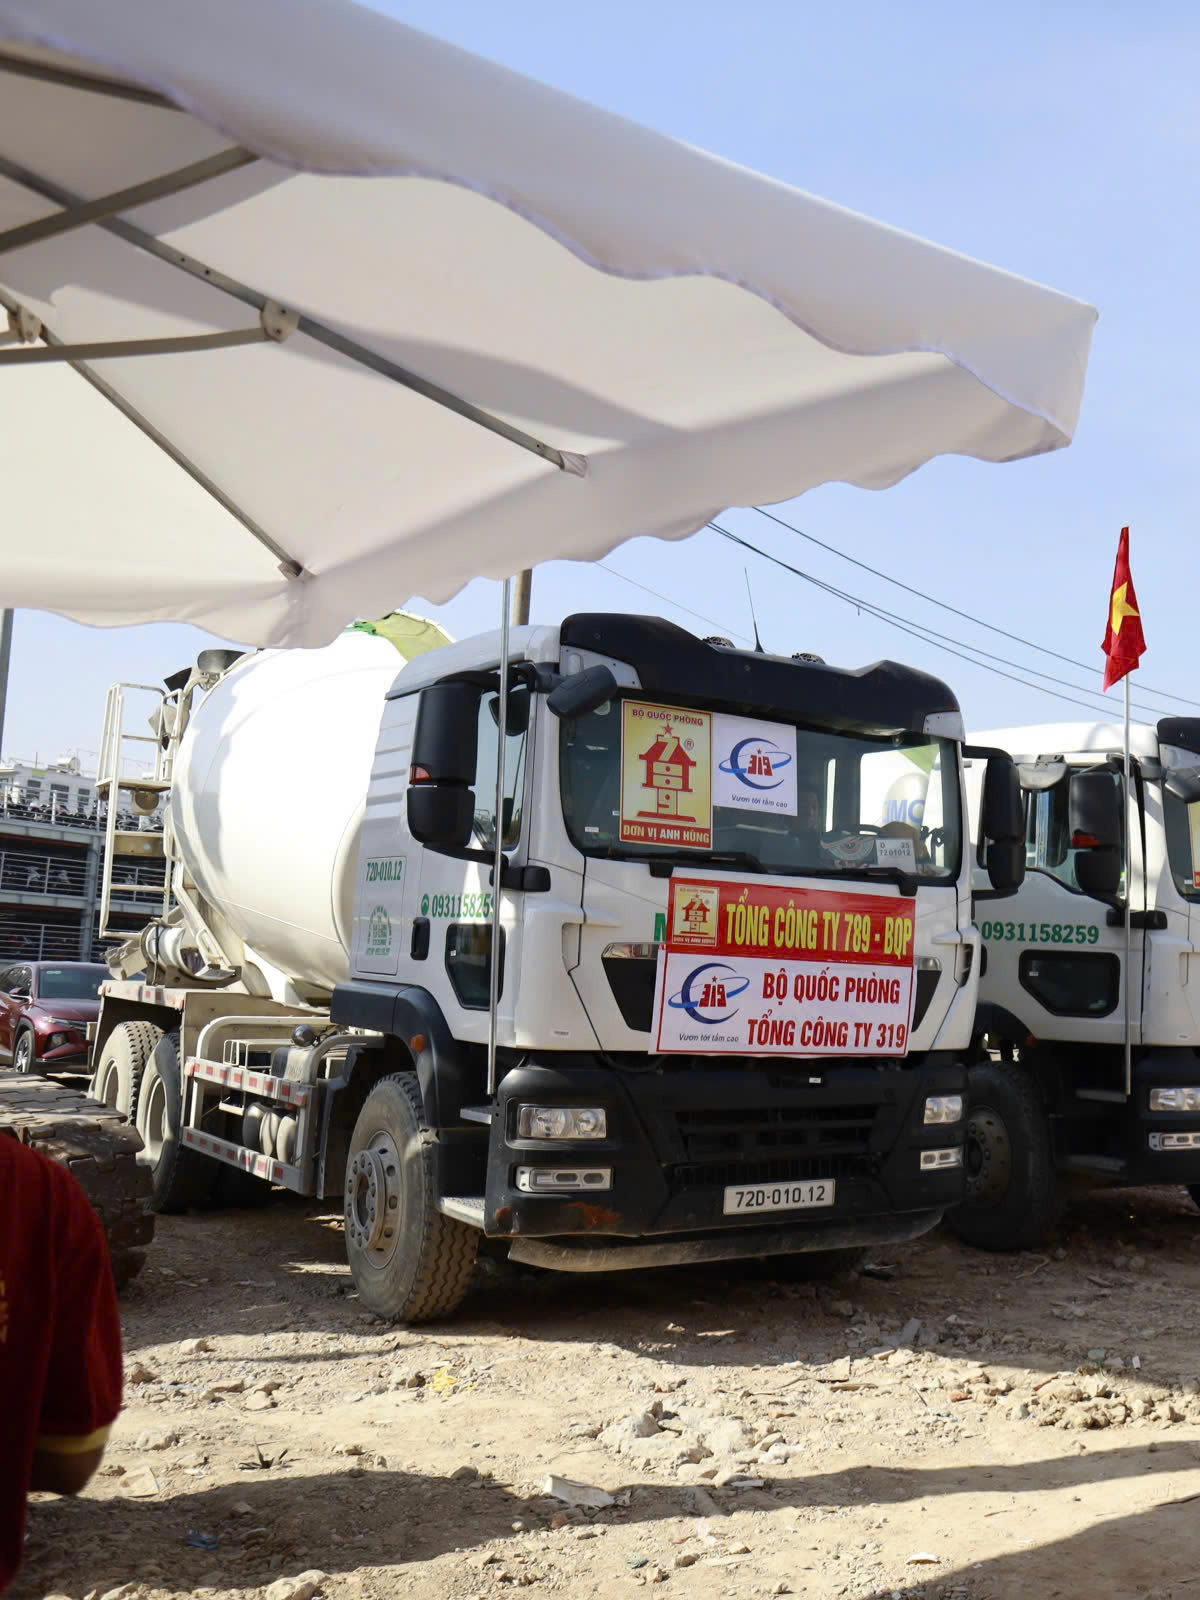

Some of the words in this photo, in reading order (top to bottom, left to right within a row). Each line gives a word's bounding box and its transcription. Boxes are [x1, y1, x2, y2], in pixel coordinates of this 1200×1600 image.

[632, 708, 645, 721] BỘ
[647, 710, 672, 722] QUỐC
[674, 714, 704, 727] PHÒNG
[647, 828, 657, 840] VỊ
[659, 828, 680, 840] ANH
[683, 829, 710, 844] HÙNG
[727, 887, 769, 947] TỔNG
[774, 899, 818, 950] CÔNG
[823, 911, 840, 951] TY
[845, 913, 871, 953] 789
[884, 916, 912, 960] BQP
[981, 921, 1099, 944] 0931158259
[762, 967, 788, 1005] BỘ
[794, 967, 840, 1004] QUỐC
[844, 971, 900, 1004] PHÒNG
[748, 1009, 795, 1046] TỔNG
[800, 1016, 849, 1047] CÔNG
[854, 1022, 873, 1048] TY
[876, 1023, 906, 1048] 319
[735, 1185, 825, 1208] 72D-010.12
